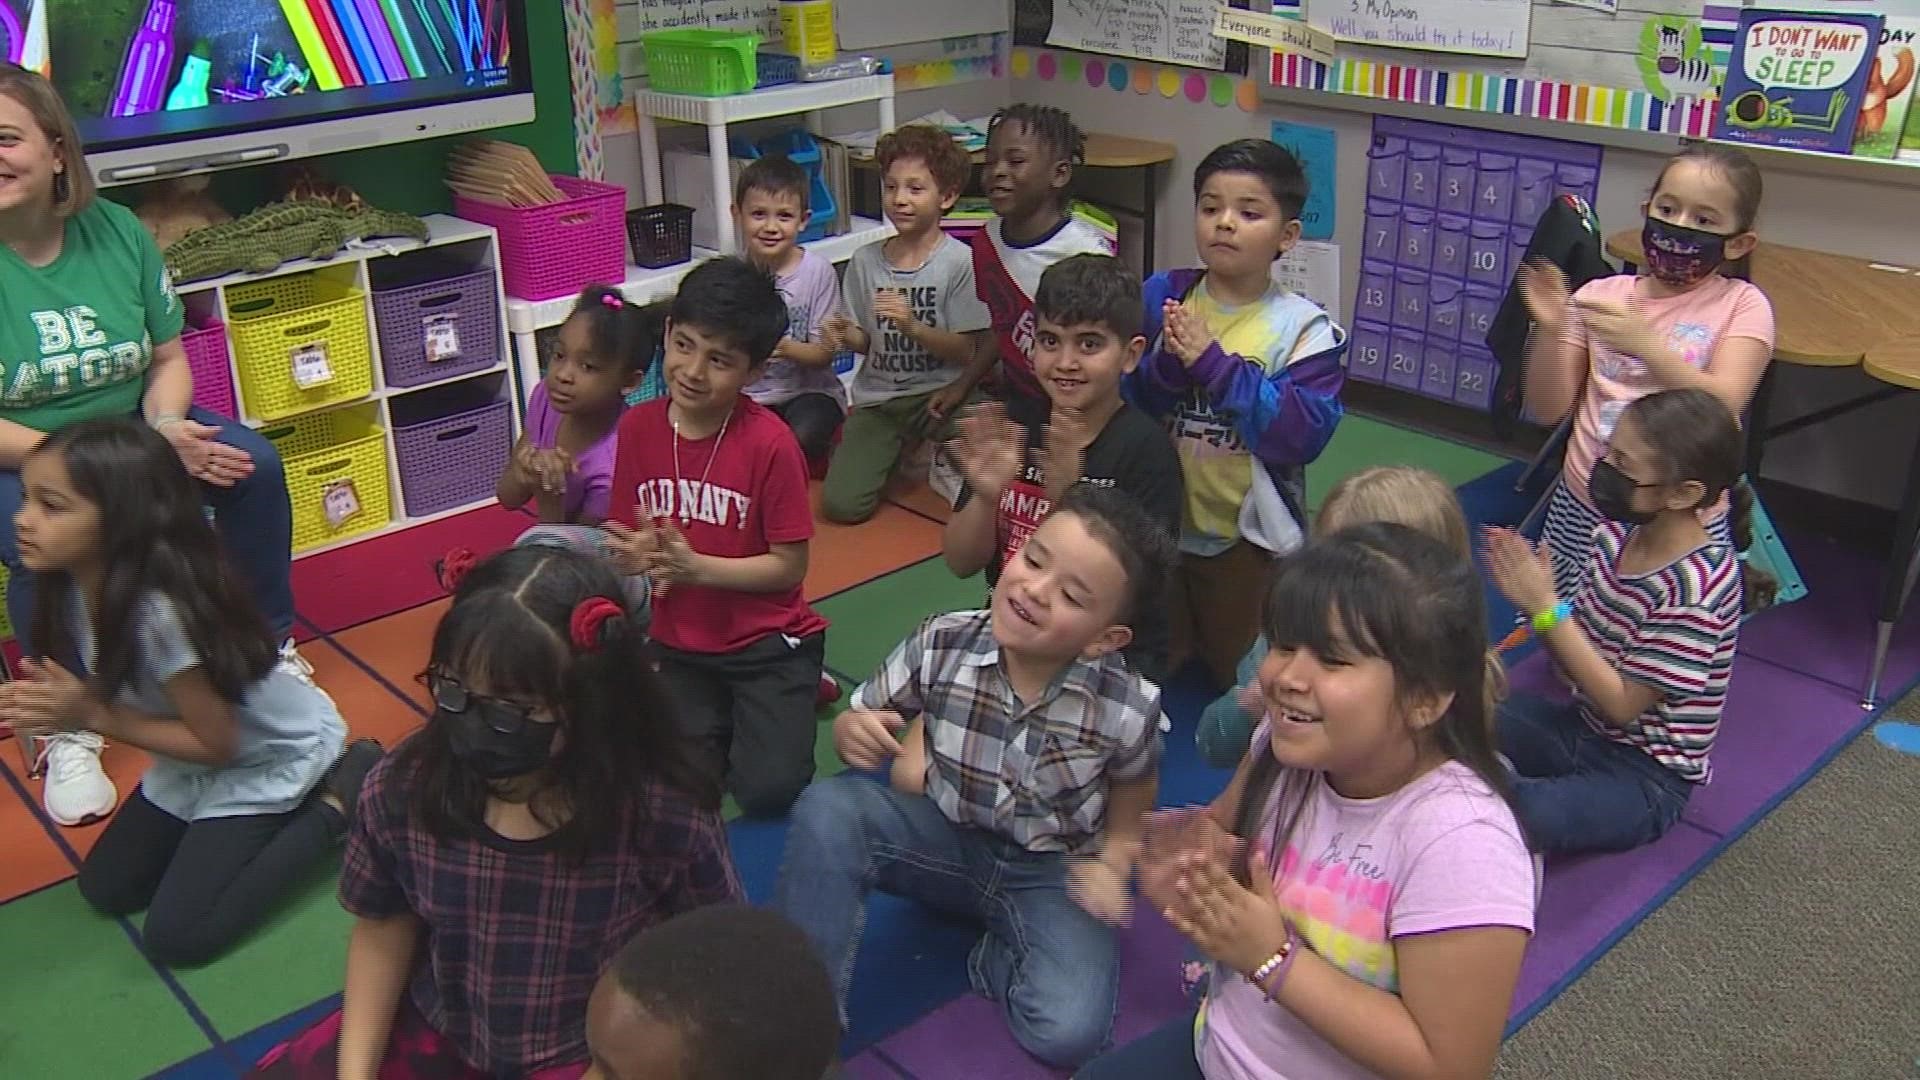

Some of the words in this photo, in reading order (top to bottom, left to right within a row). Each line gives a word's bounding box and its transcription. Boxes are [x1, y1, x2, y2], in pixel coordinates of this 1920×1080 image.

[1383, 0, 1418, 22] Opinion
[1220, 12, 1271, 38] Everyone
[1282, 25, 1313, 49] should
[1331, 16, 1355, 36] Well
[1363, 28, 1379, 41] you
[1388, 24, 1427, 43] should
[1433, 28, 1446, 47] try
[1452, 30, 1463, 45] it
[1752, 27, 1764, 47] I
[1814, 30, 1862, 52] WANT
[1878, 29, 1916, 45] DAY
[1775, 48, 1786, 57] TO
[1791, 49, 1803, 58] GO
[1810, 50, 1821, 59] TO
[1755, 56, 1834, 86] SLEEP
[1413, 172, 1424, 191] 2
[1449, 179, 1459, 197] 3
[1483, 185, 1497, 205] 4
[1376, 230, 1387, 248] 7
[1407, 239, 1418, 256] 8
[1443, 245, 1455, 261] 9
[1471, 250, 1497, 271] 10
[875, 287, 937, 307] AKE
[1365, 287, 1384, 307] 13
[1401, 298, 1420, 314] 14
[1470, 312, 1489, 332] 16
[30, 305, 108, 355] BE
[0, 330, 153, 407] ATOR
[1360, 346, 1378, 366] 19
[1391, 353, 1415, 374] 20
[1429, 362, 1448, 384] 21
[1460, 370, 1483, 393] 22
[638, 479, 675, 520] OLD
[679, 479, 752, 530] NAVY
[1345, 844, 1384, 880] Free
